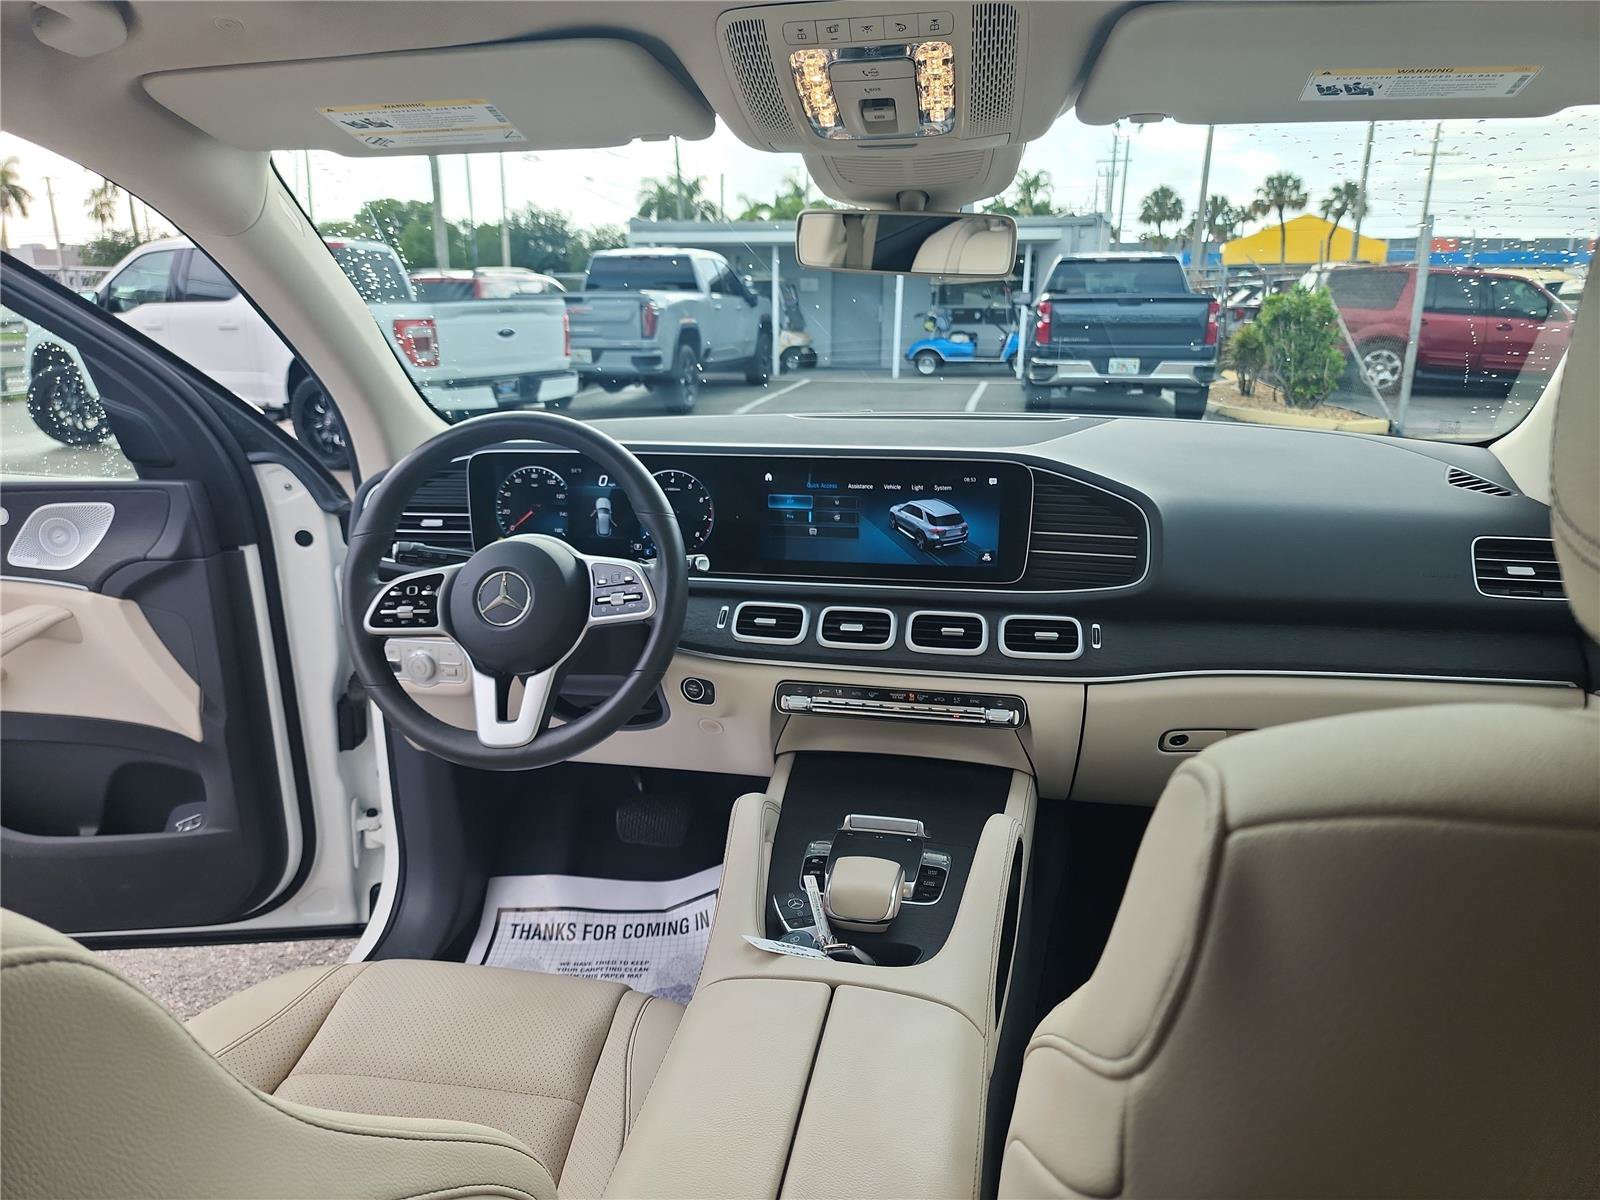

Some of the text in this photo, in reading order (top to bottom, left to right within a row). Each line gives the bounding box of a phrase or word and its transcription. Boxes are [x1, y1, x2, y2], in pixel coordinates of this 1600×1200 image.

[598, 474, 609, 487] 0
[911, 484, 924, 492] Light
[933, 484, 953, 492] System
[510, 909, 710, 942] THANKS FOR COMING IN
